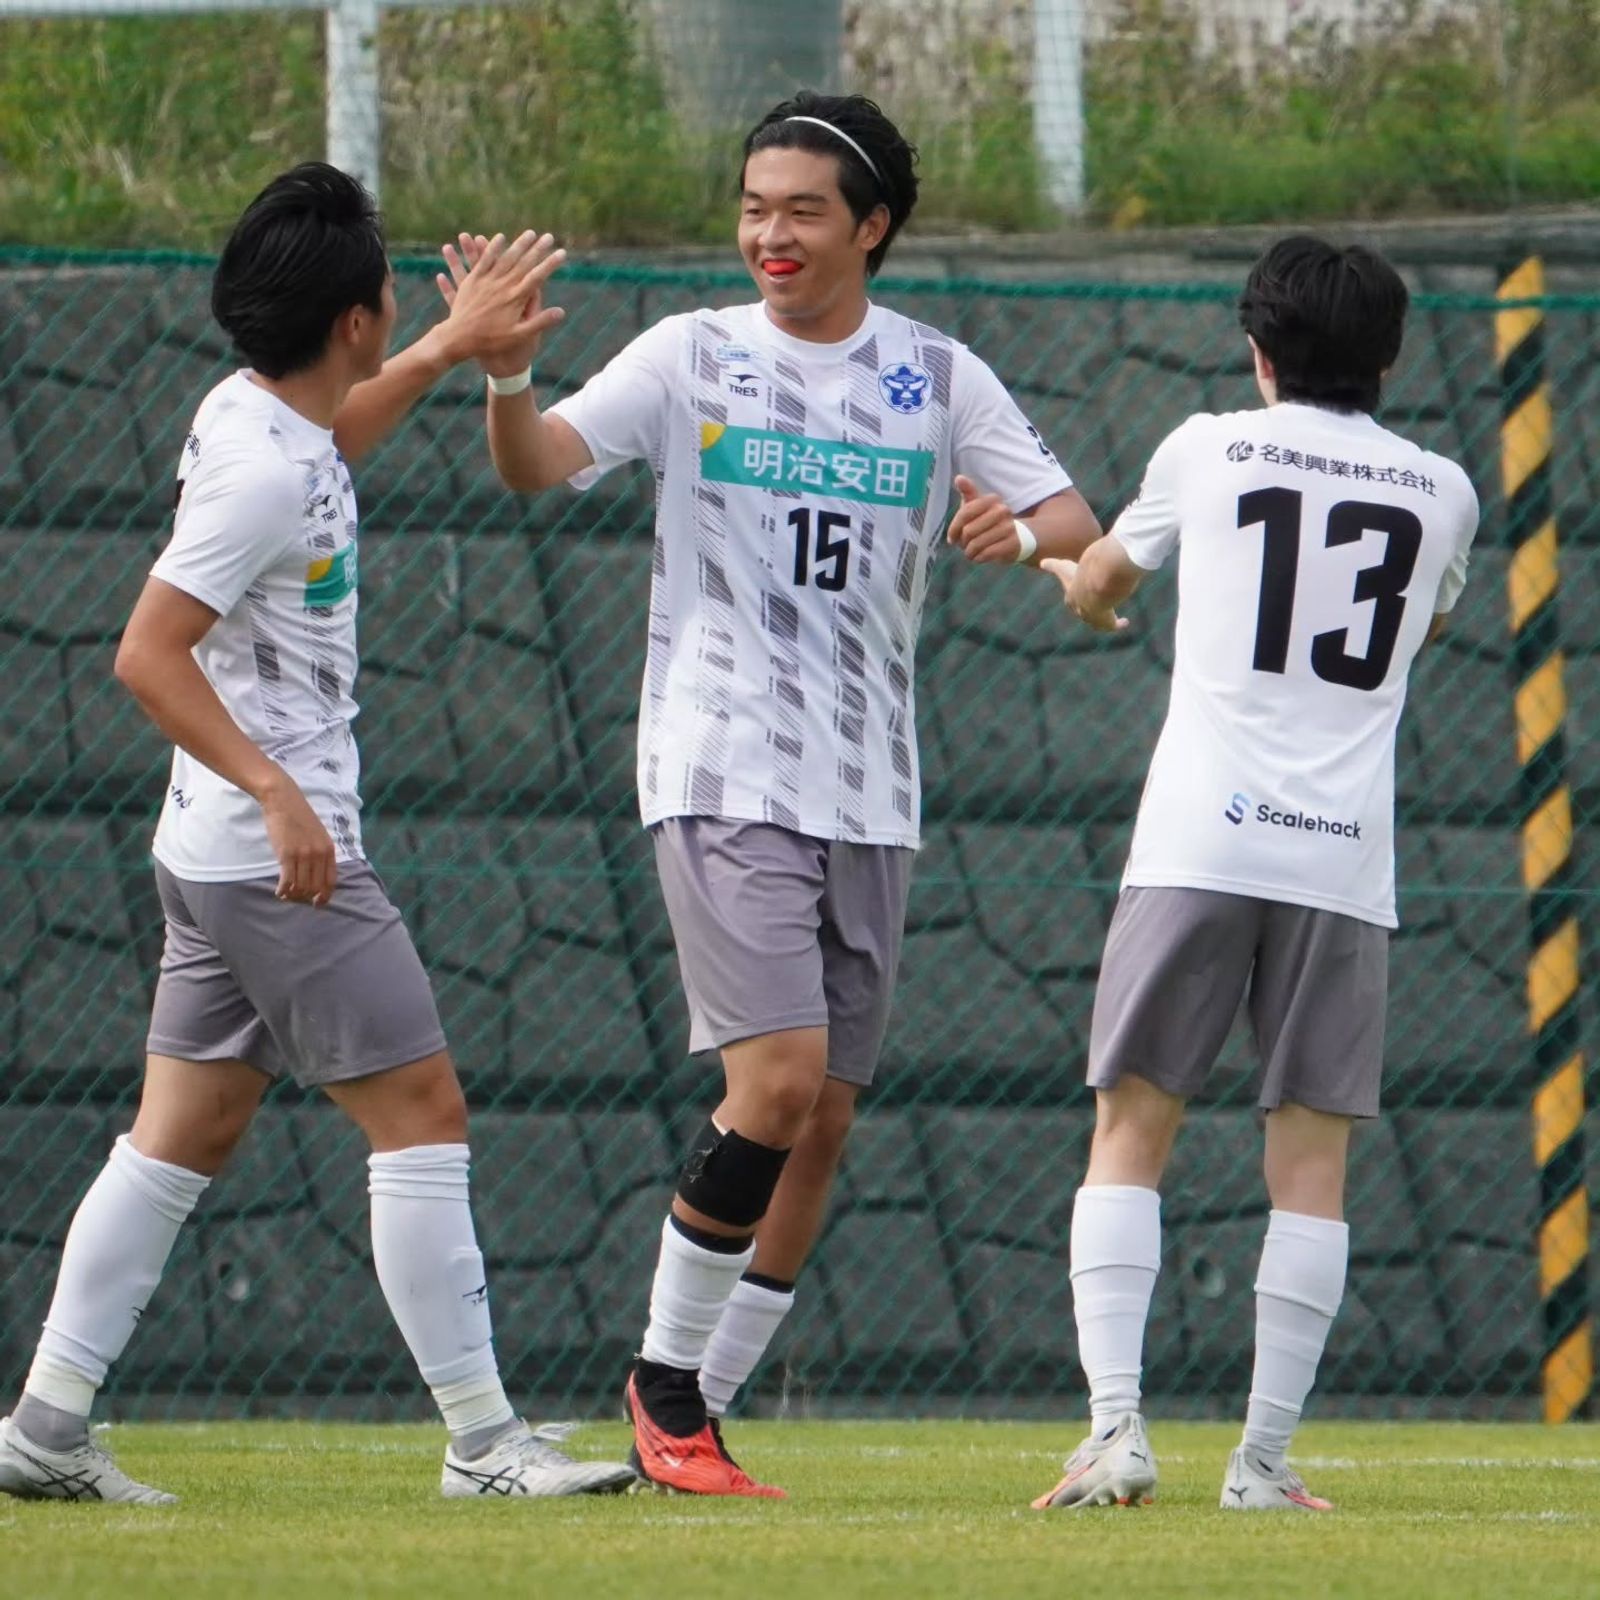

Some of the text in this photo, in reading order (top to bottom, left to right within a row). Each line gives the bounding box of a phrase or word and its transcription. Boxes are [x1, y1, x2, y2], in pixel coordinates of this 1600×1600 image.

[728, 383, 758, 398] TRES
[743, 437, 910, 498] 明治安田
[1259, 443, 1437, 497] 名美興業株式会社
[787, 506, 851, 592] 15
[1237, 486, 1423, 691] 13
[1256, 804, 1361, 840] Scalehack
